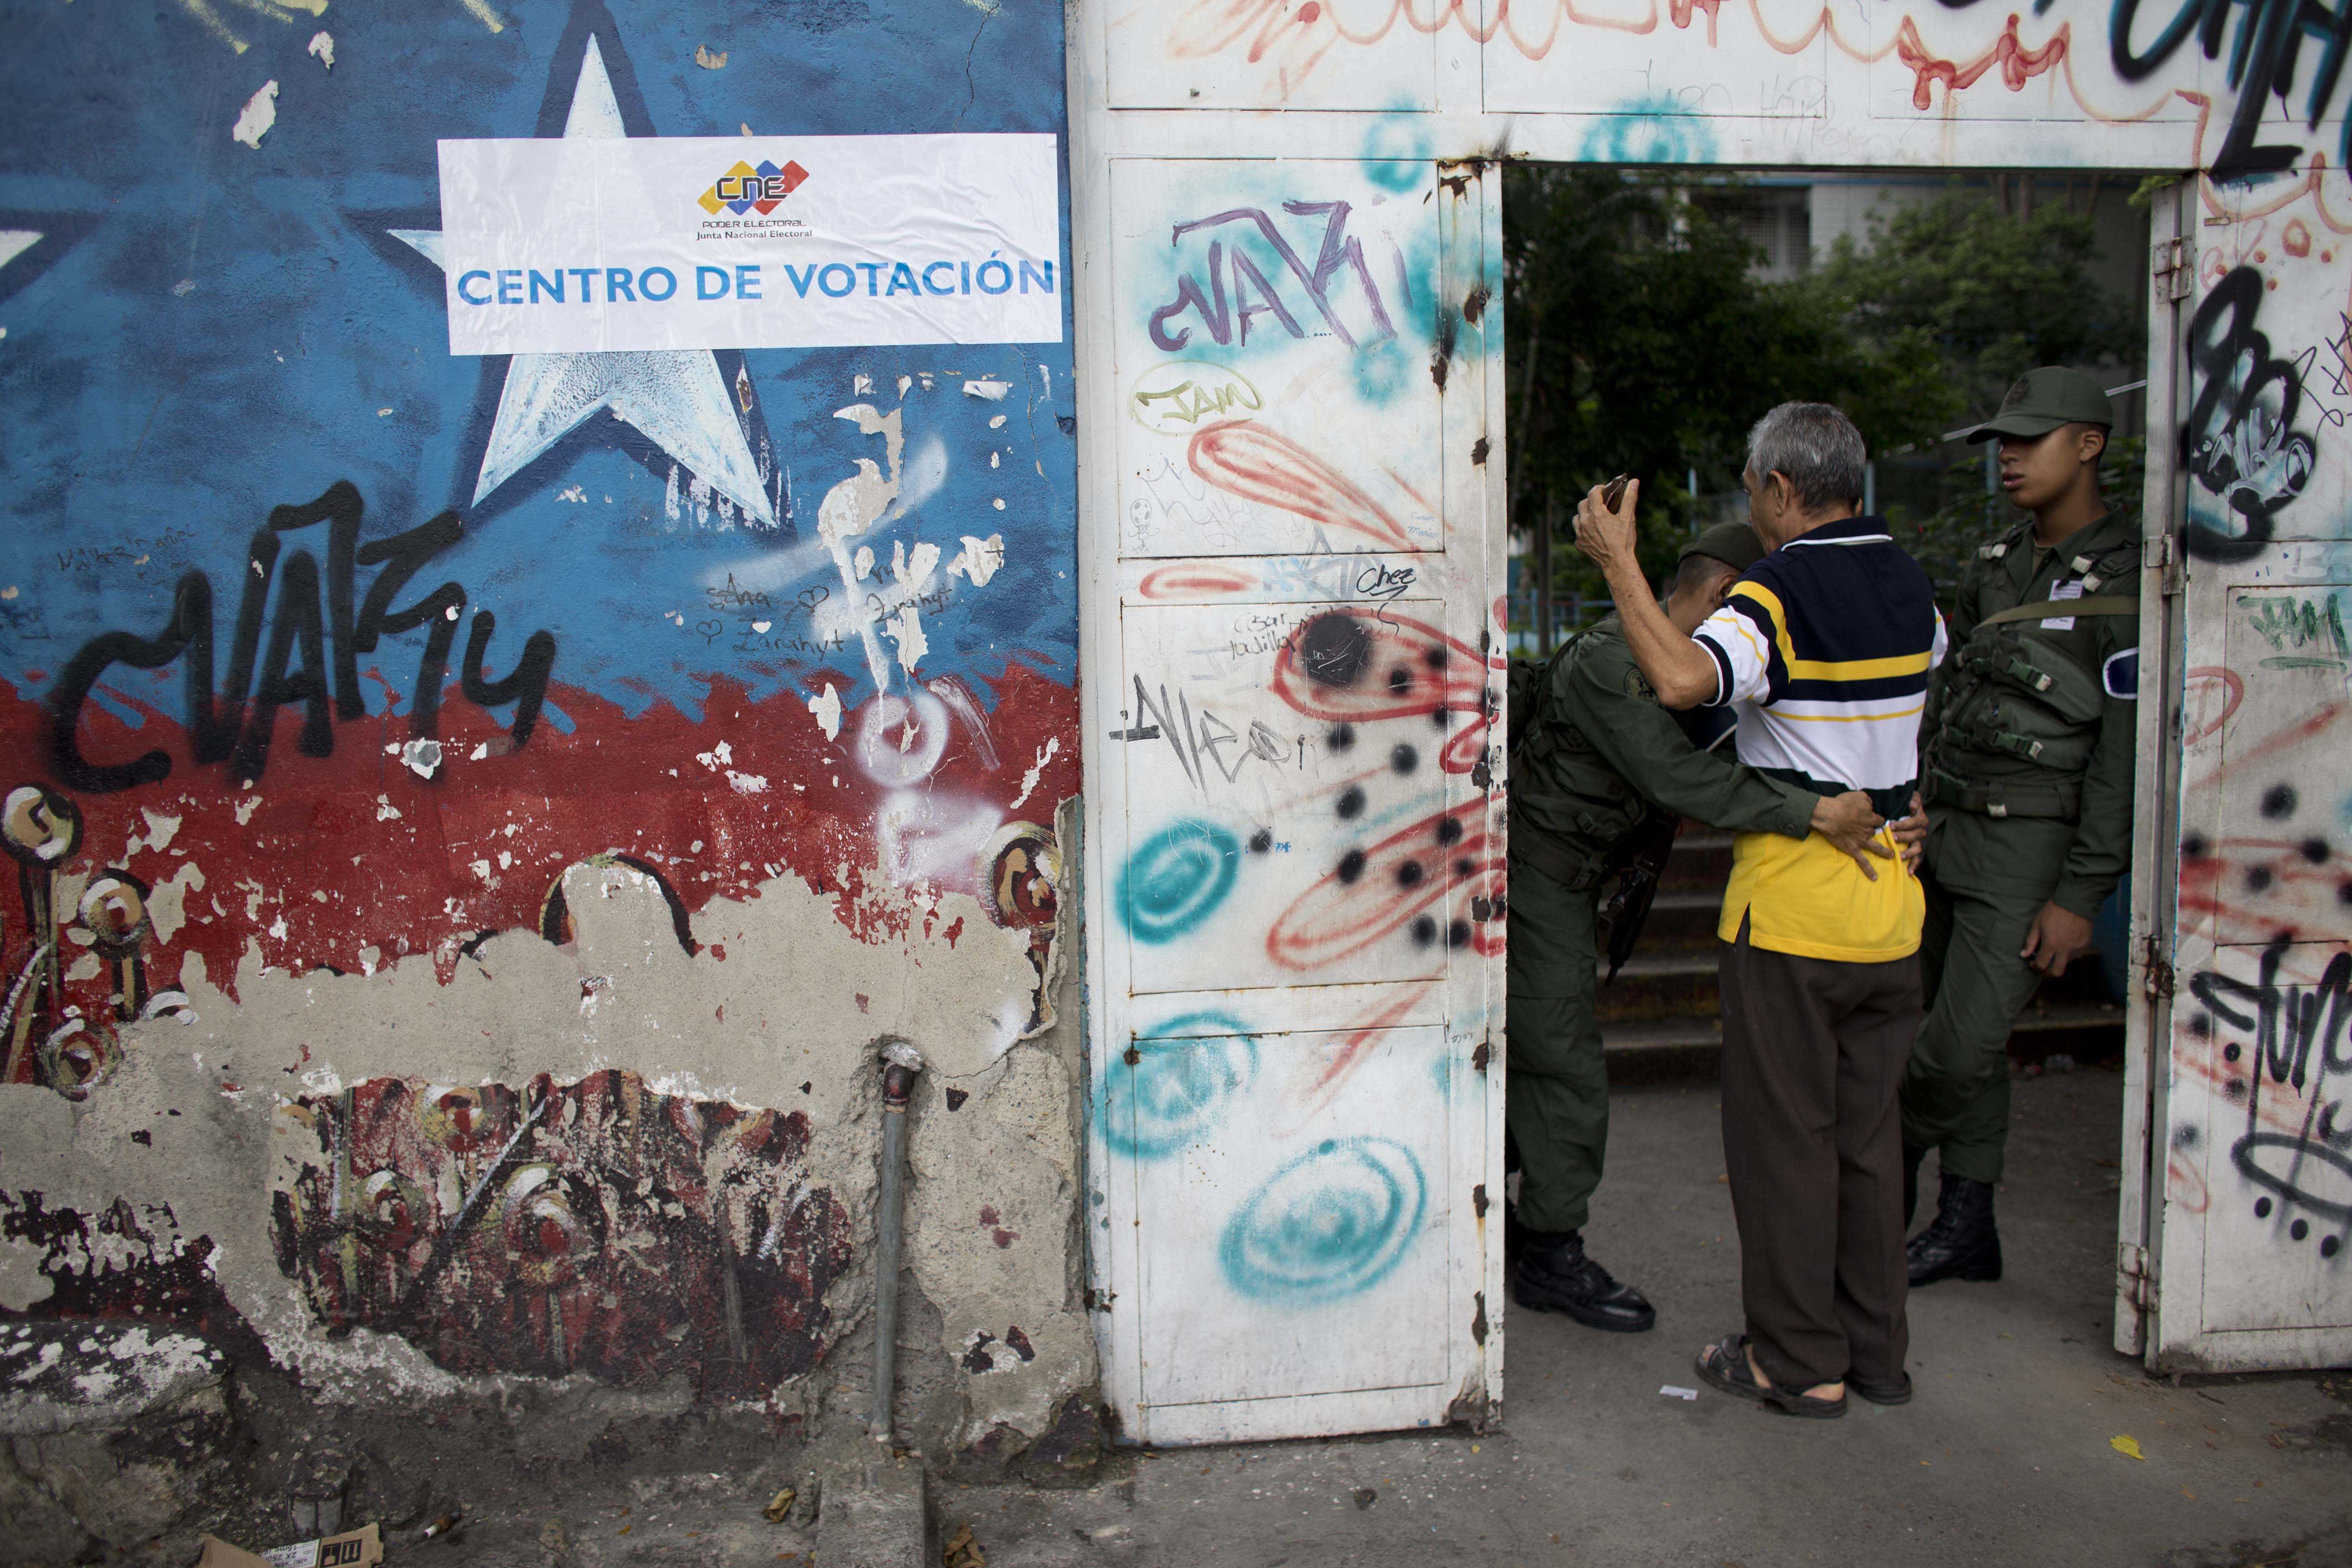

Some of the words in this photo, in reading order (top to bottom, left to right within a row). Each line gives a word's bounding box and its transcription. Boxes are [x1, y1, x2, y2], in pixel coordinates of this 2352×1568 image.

[716, 176, 789, 201] CNE
[696, 231, 722, 241] Junta
[725, 231, 767, 239] Nacional
[770, 230, 812, 238] Electoral
[457, 266, 678, 305] CENTRO
[695, 264, 762, 300] DE
[784, 250, 1055, 299] VOTACIÓN
